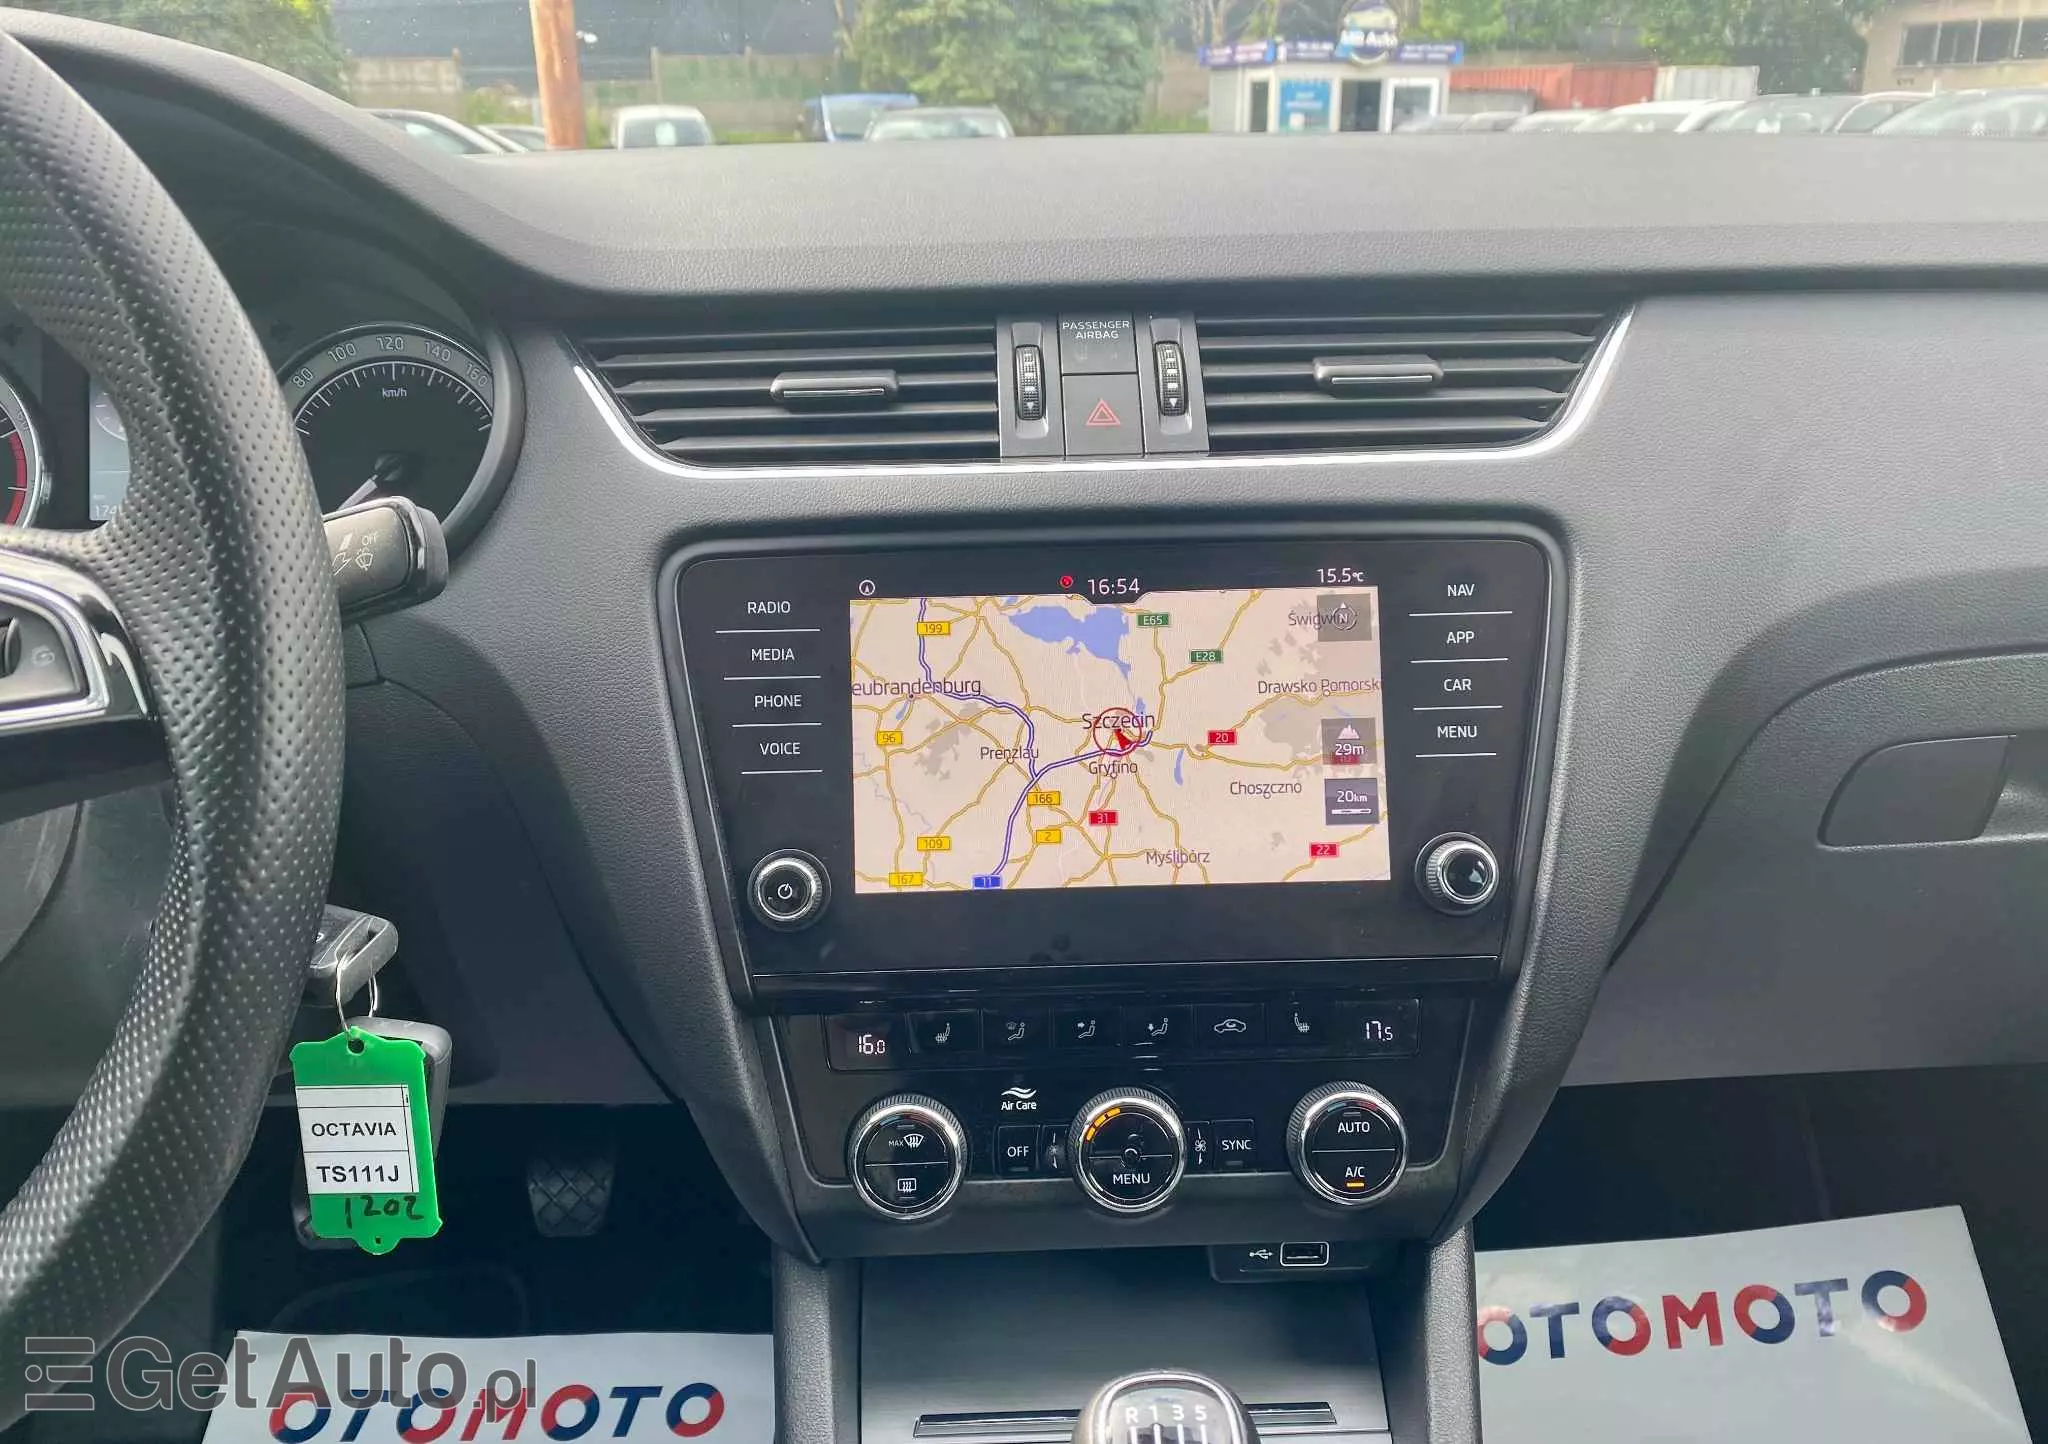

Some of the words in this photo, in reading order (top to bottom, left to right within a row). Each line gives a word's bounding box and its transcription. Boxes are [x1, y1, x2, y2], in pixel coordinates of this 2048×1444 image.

[1062, 320, 1130, 330] PASSENGER
[1075, 330, 1119, 339] AIRBAG
[376, 336, 404, 351] 120
[328, 343, 357, 362] 100
[425, 342, 452, 361] 140
[292, 367, 314, 389] 80
[465, 363, 489, 388] 160
[382, 388, 407, 398] km/h
[1087, 578, 1140, 595] 16:54
[1447, 583, 1475, 597] NAV
[747, 600, 791, 614] RADIO
[1143, 615, 1163, 626] E65
[923, 623, 943, 634] 199
[1446, 631, 1475, 644] APP
[751, 648, 795, 661] MEDIA
[1195, 651, 1216, 662] E28
[1257, 680, 1317, 694] Drawsko
[1443, 678, 1472, 691] CAR
[754, 695, 802, 708] PHONE
[1082, 712, 1155, 730] Szczecin
[1215, 732, 1229, 743] 20
[1437, 725, 1478, 738] MENU
[760, 742, 801, 755] VOICE
[980, 746, 1039, 760] Prenzlau
[1335, 743, 1364, 756] 29m
[1088, 761, 1138, 775] Gryfino
[1230, 780, 1302, 796] Choszczno
[1033, 793, 1053, 804] 166
[1336, 790, 1368, 802] 20km
[1096, 813, 1109, 824] 31
[923, 839, 943, 849] 109
[1316, 844, 1330, 855] 22
[1146, 849, 1210, 868] Myślibórz
[1000, 1100, 1014, 1110] Air
[1016, 1100, 1037, 1110] Care
[311, 1122, 397, 1137] OCTAVIA
[1337, 1121, 1371, 1133] AUTO
[888, 1139, 904, 1147] MAX
[1221, 1139, 1252, 1151] SYNC
[1007, 1146, 1029, 1158] OFF
[316, 1165, 400, 1183] TS111J
[1345, 1166, 1365, 1178] A/C
[1112, 1173, 1151, 1185] MENU
[344, 1194, 424, 1229] 1202
[1476, 1270, 1928, 1366] OTOMOTO
[267, 1382, 726, 1443] OTOMOTO
[1125, 1407, 1139, 1424] R
[1149, 1405, 1158, 1421] 1
[1171, 1405, 1185, 1421] 3
[1194, 1405, 1208, 1422] 5
